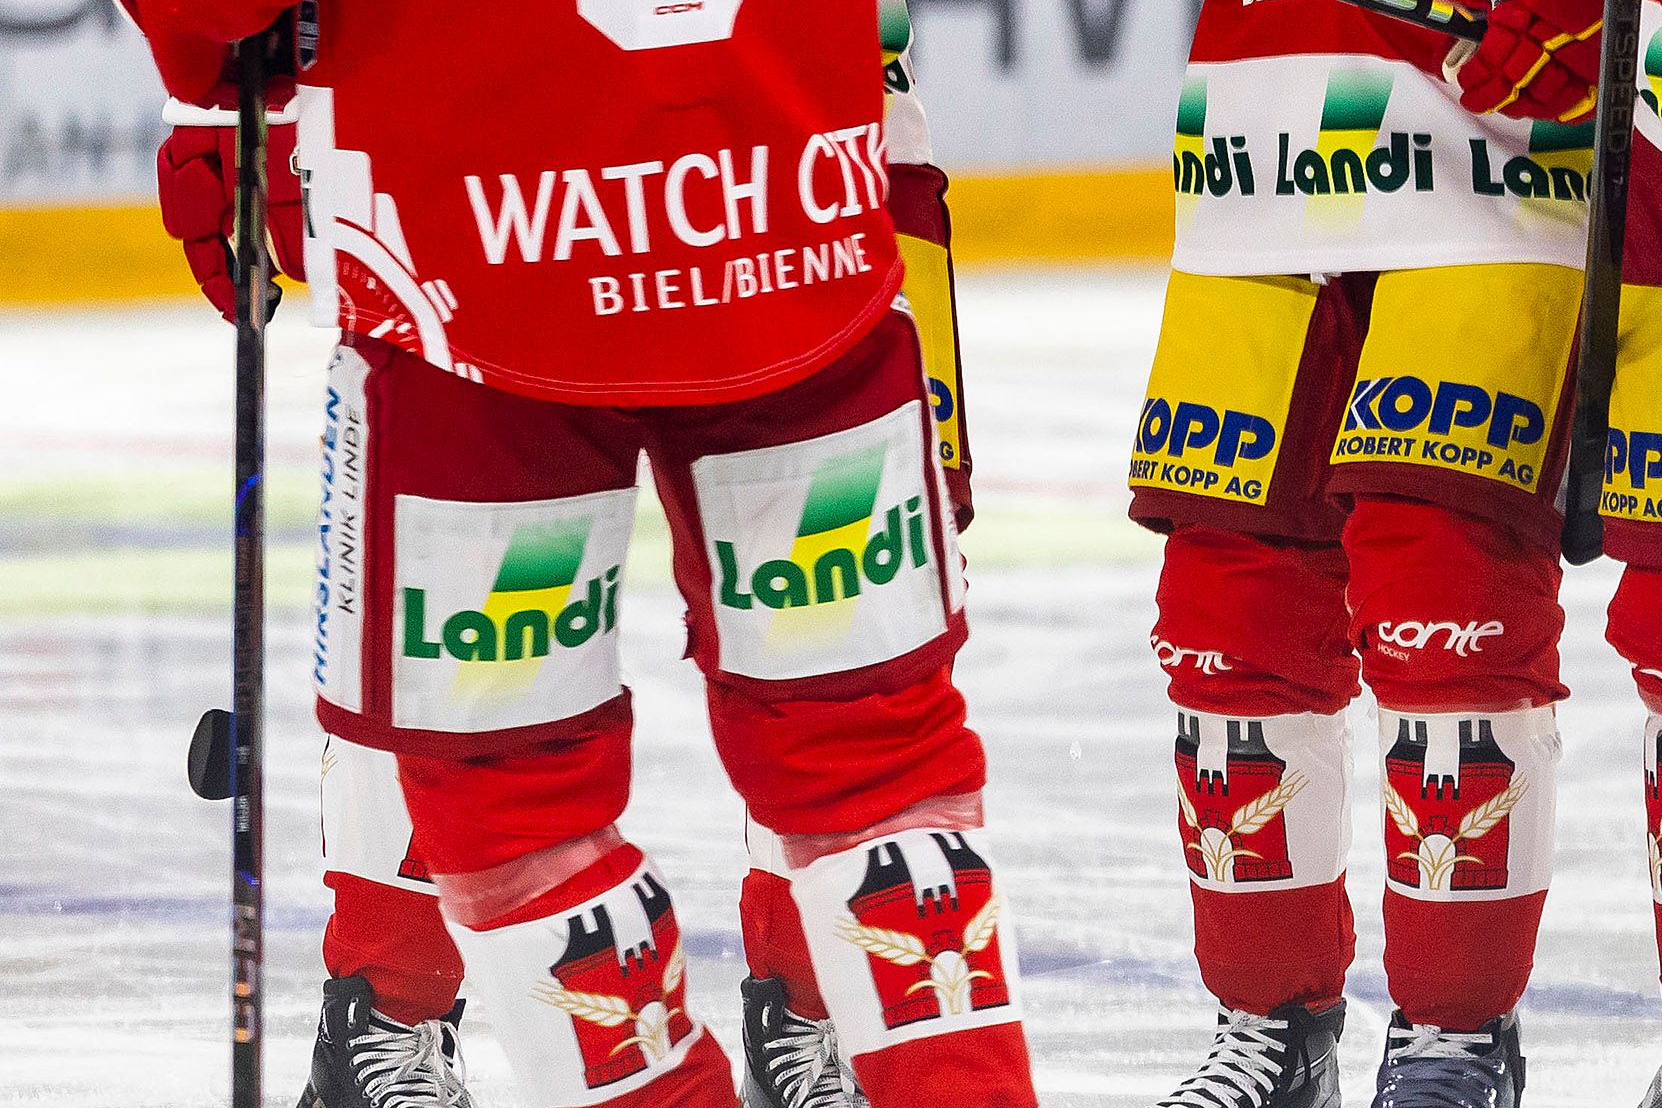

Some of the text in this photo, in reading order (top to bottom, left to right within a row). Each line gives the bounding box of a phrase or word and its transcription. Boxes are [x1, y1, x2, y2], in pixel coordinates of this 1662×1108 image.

[652, 0, 704, 16] CCM
[1276, 131, 1435, 196] Landi
[1469, 138, 1592, 202] Lan
[464, 144, 769, 266] WATCH
[588, 232, 873, 317] BIEL/BIENNE
[1344, 375, 1547, 451] KOPP
[1161, 466, 1219, 491] KOPP
[1223, 476, 1263, 501] AG
[1335, 434, 1536, 486] ROBERT KOPP AG
[337, 512, 358, 615] KLINIK
[715, 494, 929, 611] Landi
[400, 564, 622, 663] Landi
[1379, 620, 1504, 658] conte
